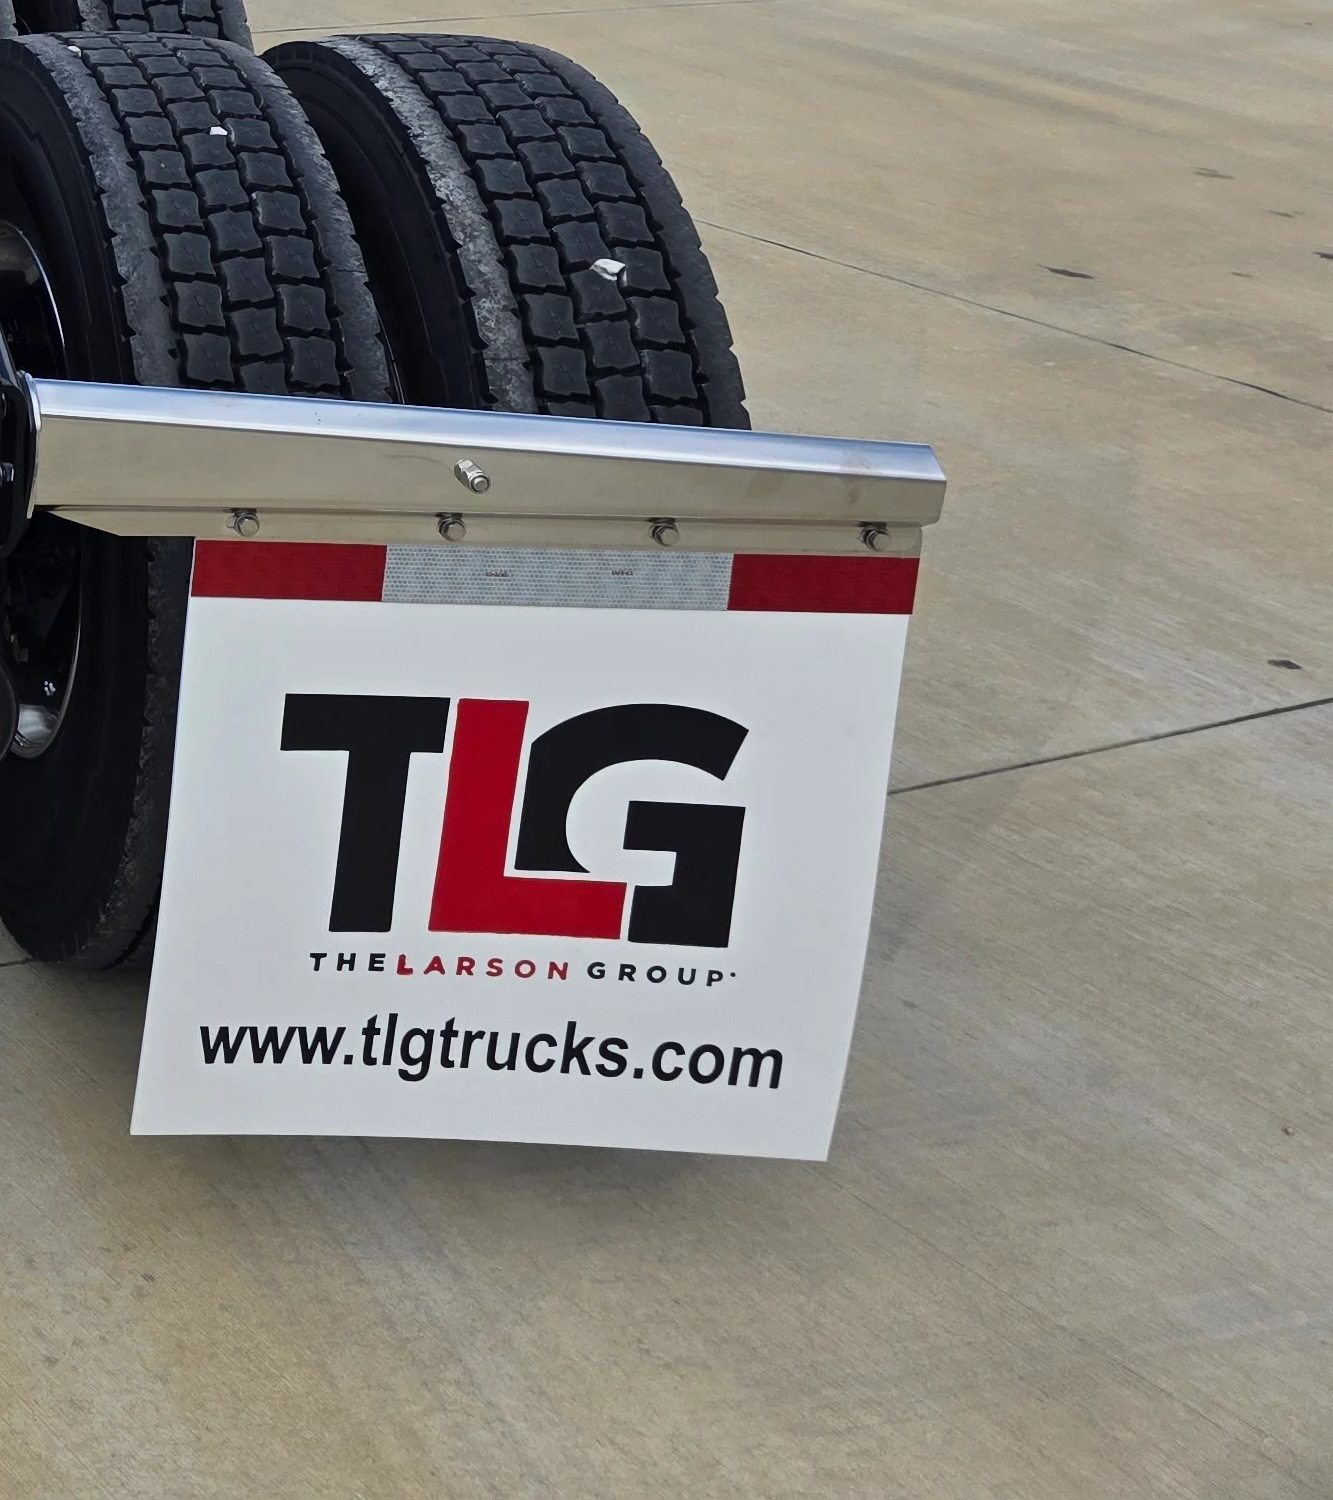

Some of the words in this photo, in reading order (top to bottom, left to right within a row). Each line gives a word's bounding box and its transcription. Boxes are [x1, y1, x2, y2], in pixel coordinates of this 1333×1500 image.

[280, 693, 749, 948] TLG
[587, 962, 724, 987] GROUP
[200, 1013, 782, 1089] www.tlgtrucks.com
